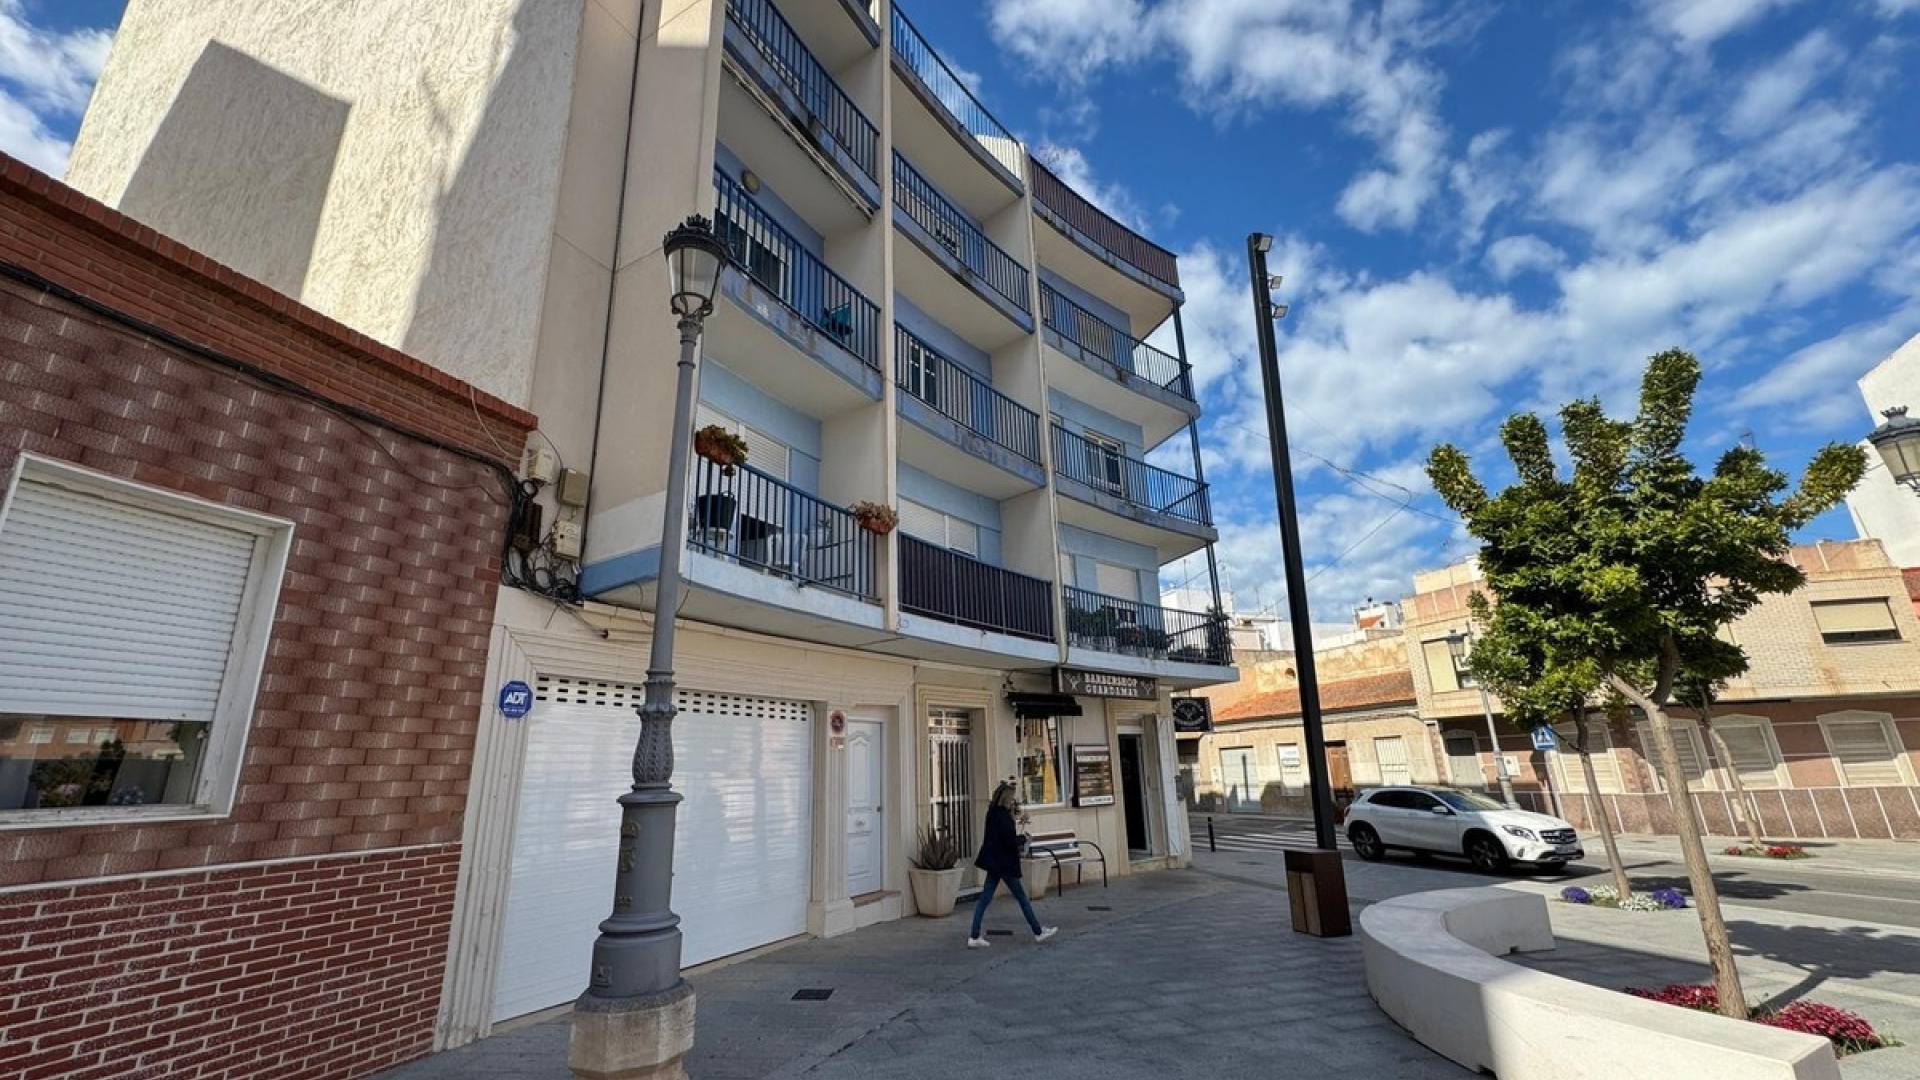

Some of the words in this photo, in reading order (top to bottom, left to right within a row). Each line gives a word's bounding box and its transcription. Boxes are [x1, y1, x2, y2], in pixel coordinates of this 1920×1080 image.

[1084, 672, 1138, 688] BARBERSHOP
[1084, 683, 1139, 697] GUARDAMAR
[504, 692, 527, 705] ADT
